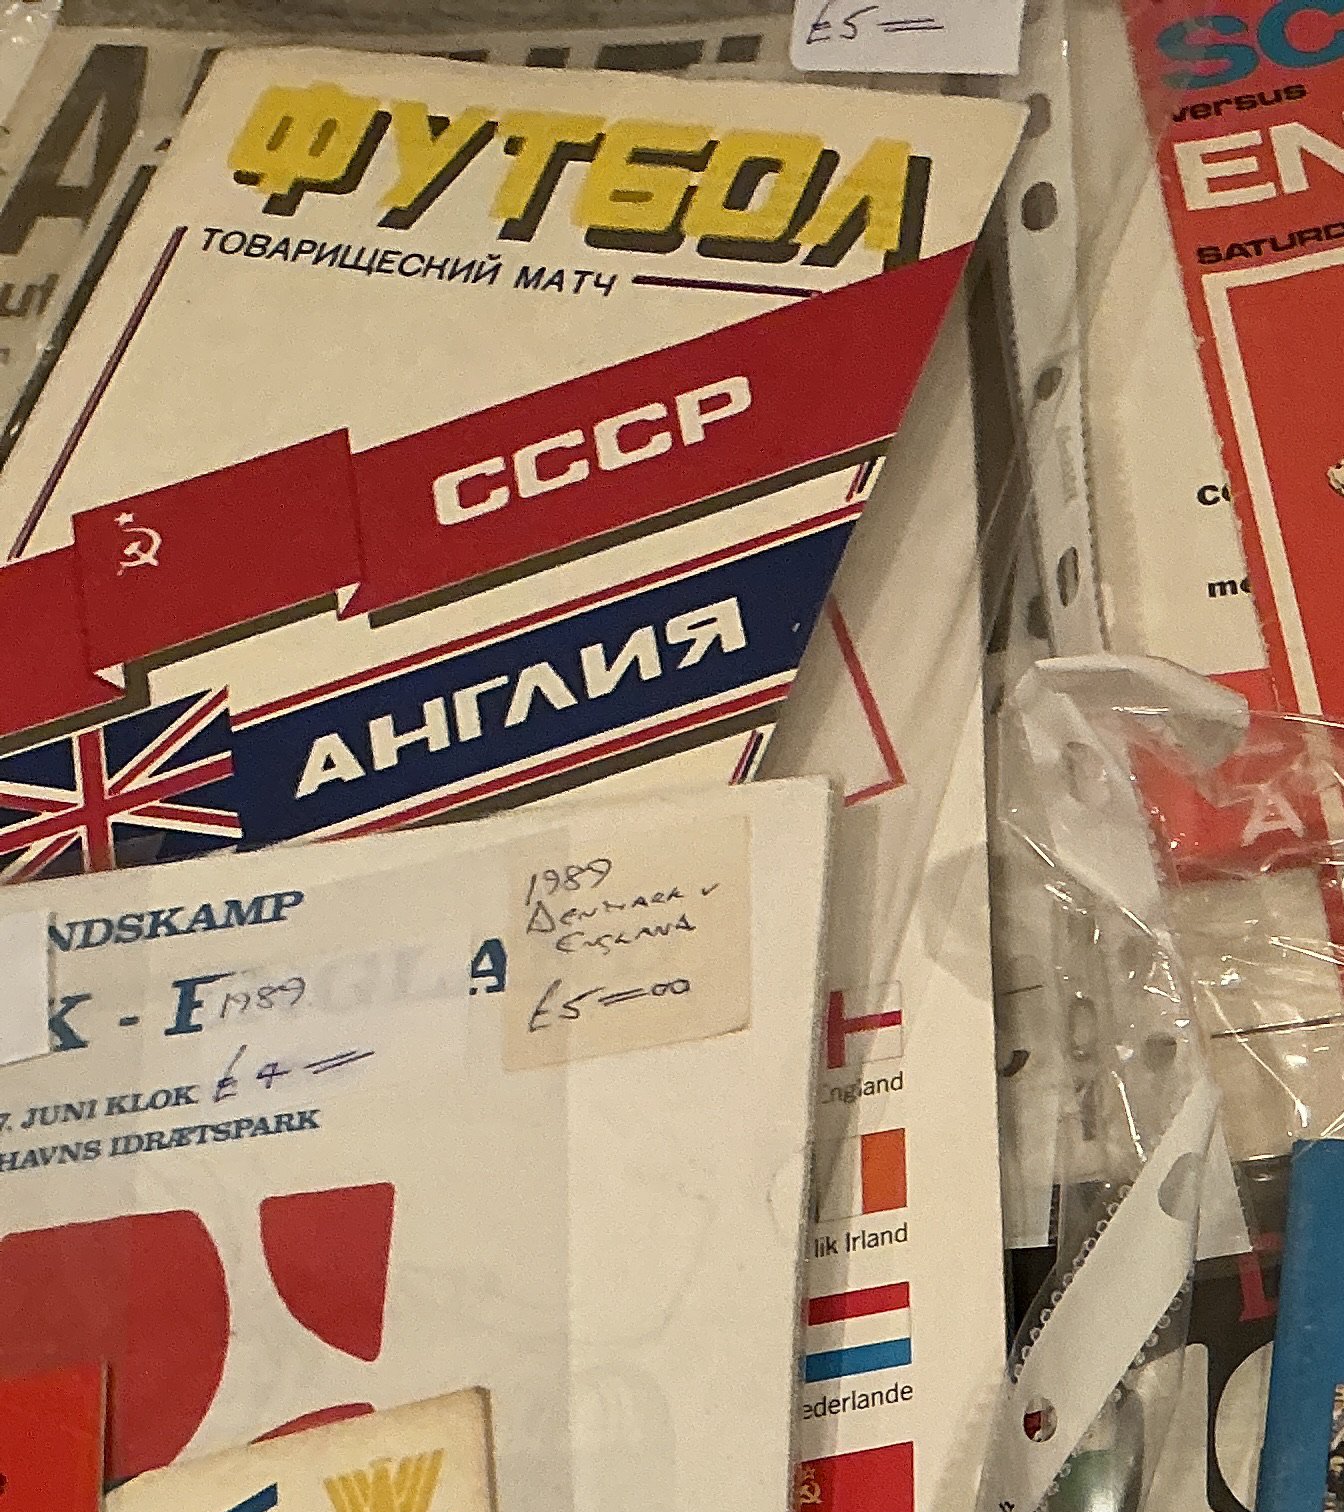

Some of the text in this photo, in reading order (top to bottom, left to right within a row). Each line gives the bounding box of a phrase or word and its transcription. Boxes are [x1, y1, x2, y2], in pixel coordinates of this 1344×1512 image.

[1172, 84, 1307, 122] versus
[228, 80, 932, 268] ФУТБОЛ
[201, 226, 617, 297] ТОВАРИЩЕСКИЙ МАТЧ
[432, 375, 752, 525] СССР
[294, 597, 749, 798] АНГЛИЯ
[525, 858, 612, 906] 1989
[21, 1100, 98, 1130] JUNI
[104, 1085, 200, 1117] KLOK
[109, 1108, 321, 1157] IDRÆTSPARK
[846, 1222, 908, 1252] Irland
